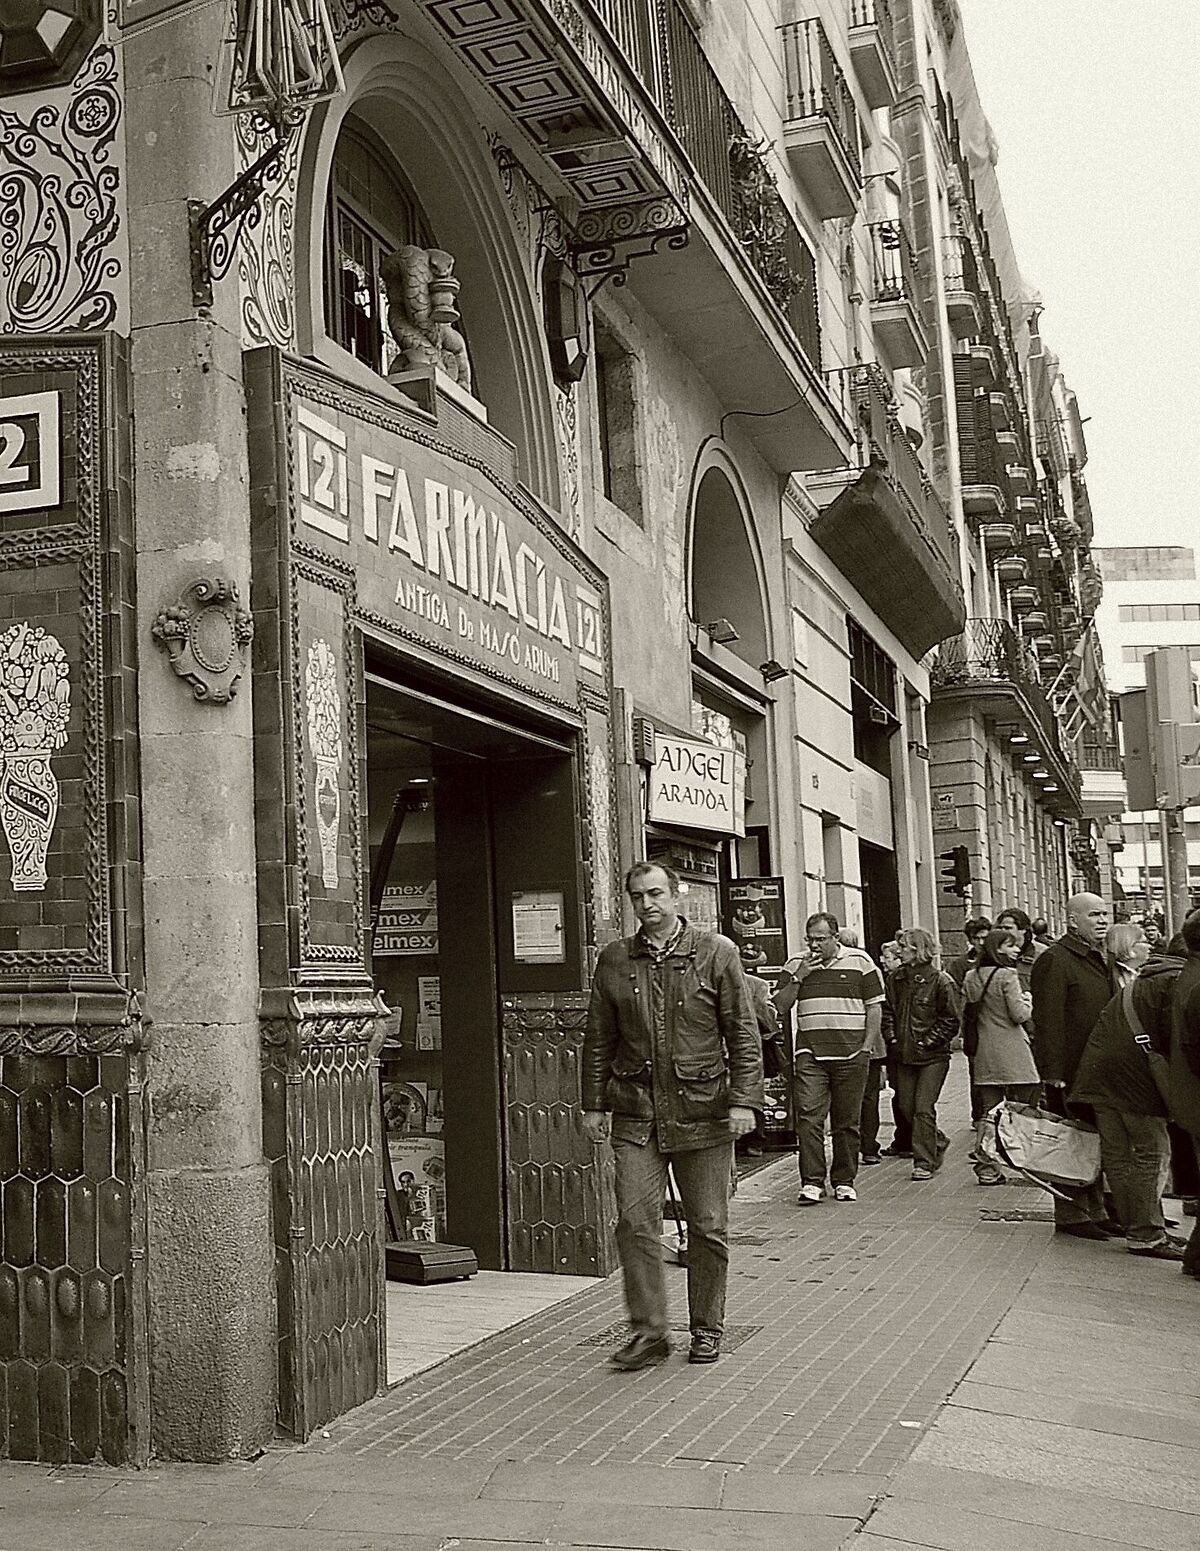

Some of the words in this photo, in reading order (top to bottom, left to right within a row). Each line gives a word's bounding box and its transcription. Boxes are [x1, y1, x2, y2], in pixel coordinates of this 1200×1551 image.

[656, 745, 730, 785] ANGEL
[656, 783, 729, 812] ARANDA
[382, 884, 424, 896] lmex
[373, 934, 433, 949] elmex
